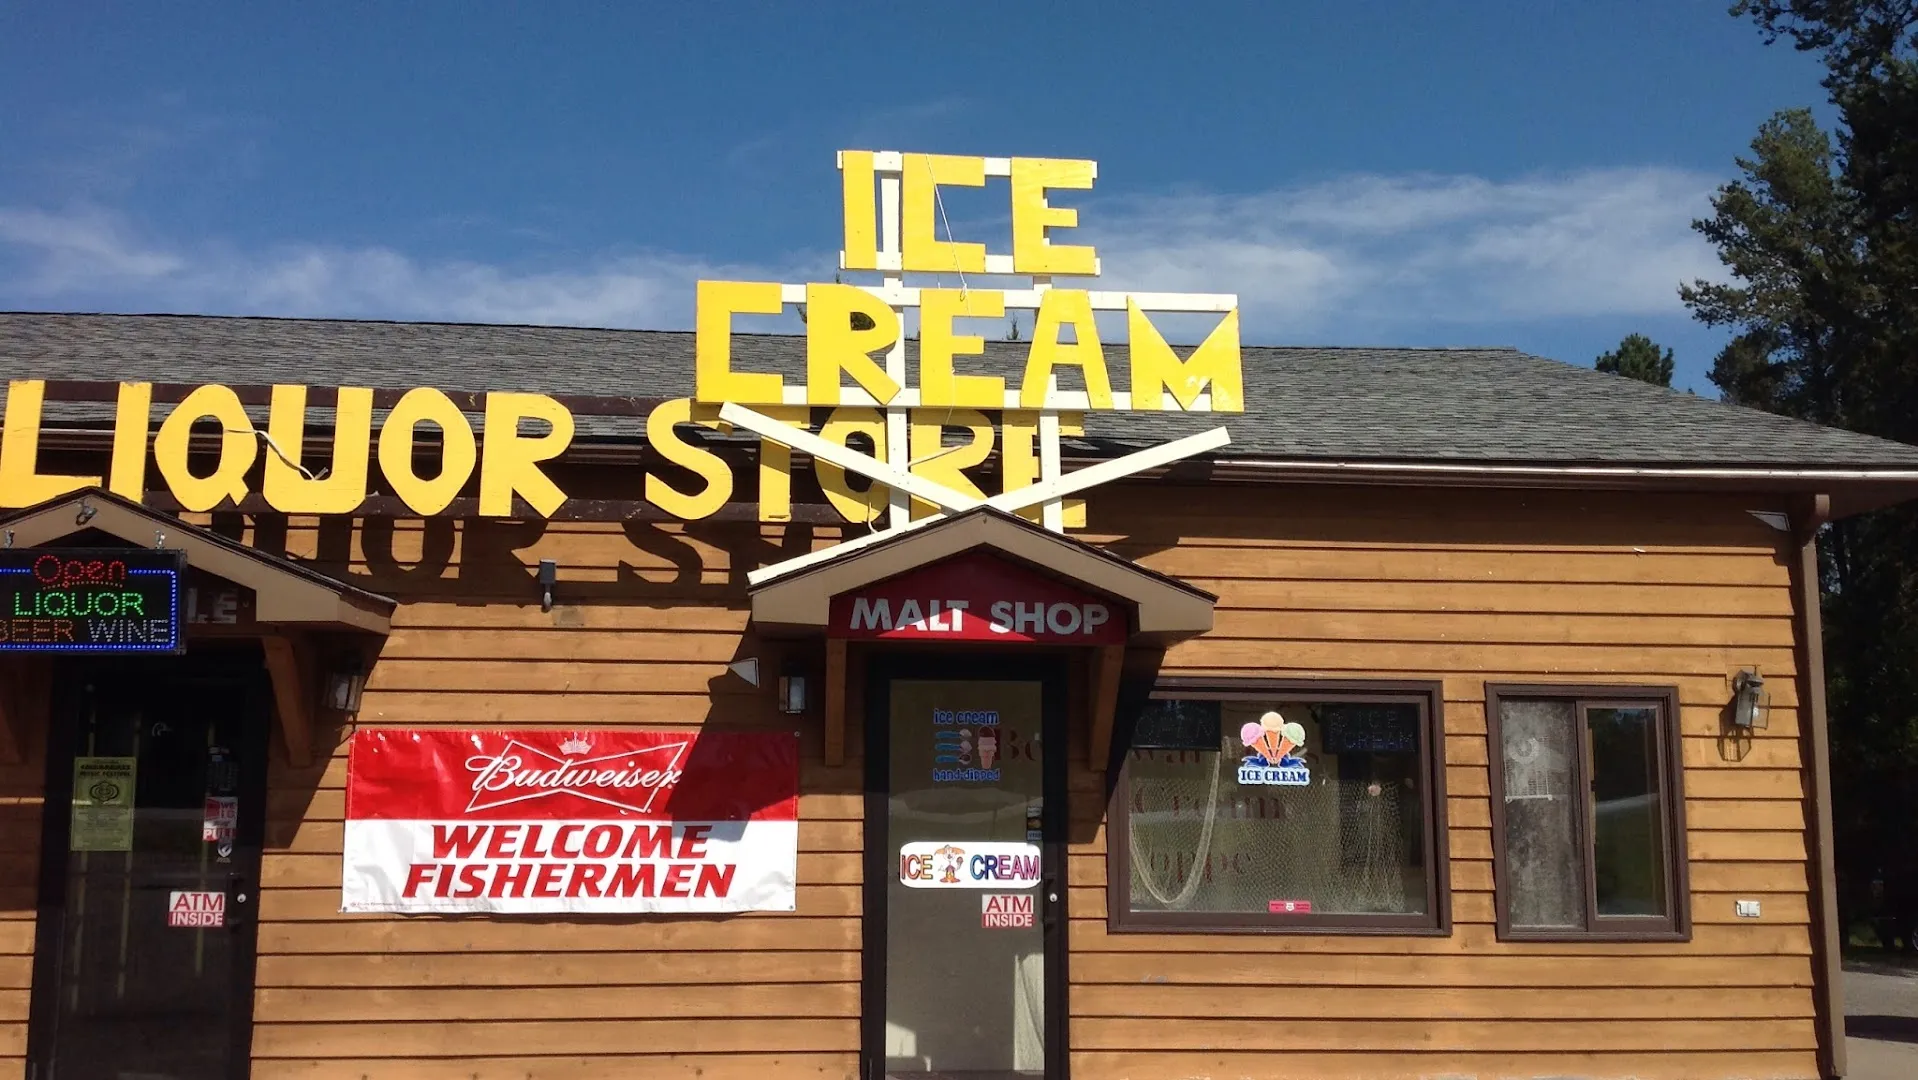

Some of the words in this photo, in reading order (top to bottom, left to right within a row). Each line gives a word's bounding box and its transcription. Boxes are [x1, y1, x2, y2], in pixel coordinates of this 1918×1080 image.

[842, 150, 1096, 275] ICE
[696, 280, 1244, 412] CREAM
[0, 379, 575, 518] LIQUOR
[645, 397, 1086, 528] STORE
[33, 554, 127, 586] Open
[15, 592, 145, 617] LIQUOR
[850, 597, 969, 632] MALT
[989, 600, 1110, 635] SHOP
[87, 618, 169, 643] WINE
[933, 708, 954, 724] ice
[955, 710, 1000, 724] cream
[465, 753, 682, 792] Budweiser
[1240, 770, 1261, 782] ICE
[1264, 770, 1307, 782] CREAM
[431, 823, 713, 859] WELCOME
[900, 854, 933, 880] ICE
[969, 854, 1041, 880] CREAM
[402, 863, 736, 899] FISHERMEN
[173, 893, 223, 911] ATM
[985, 895, 1031, 912] ATM
[171, 913, 223, 926] INSIDE
[985, 915, 1032, 927] INSIDE
